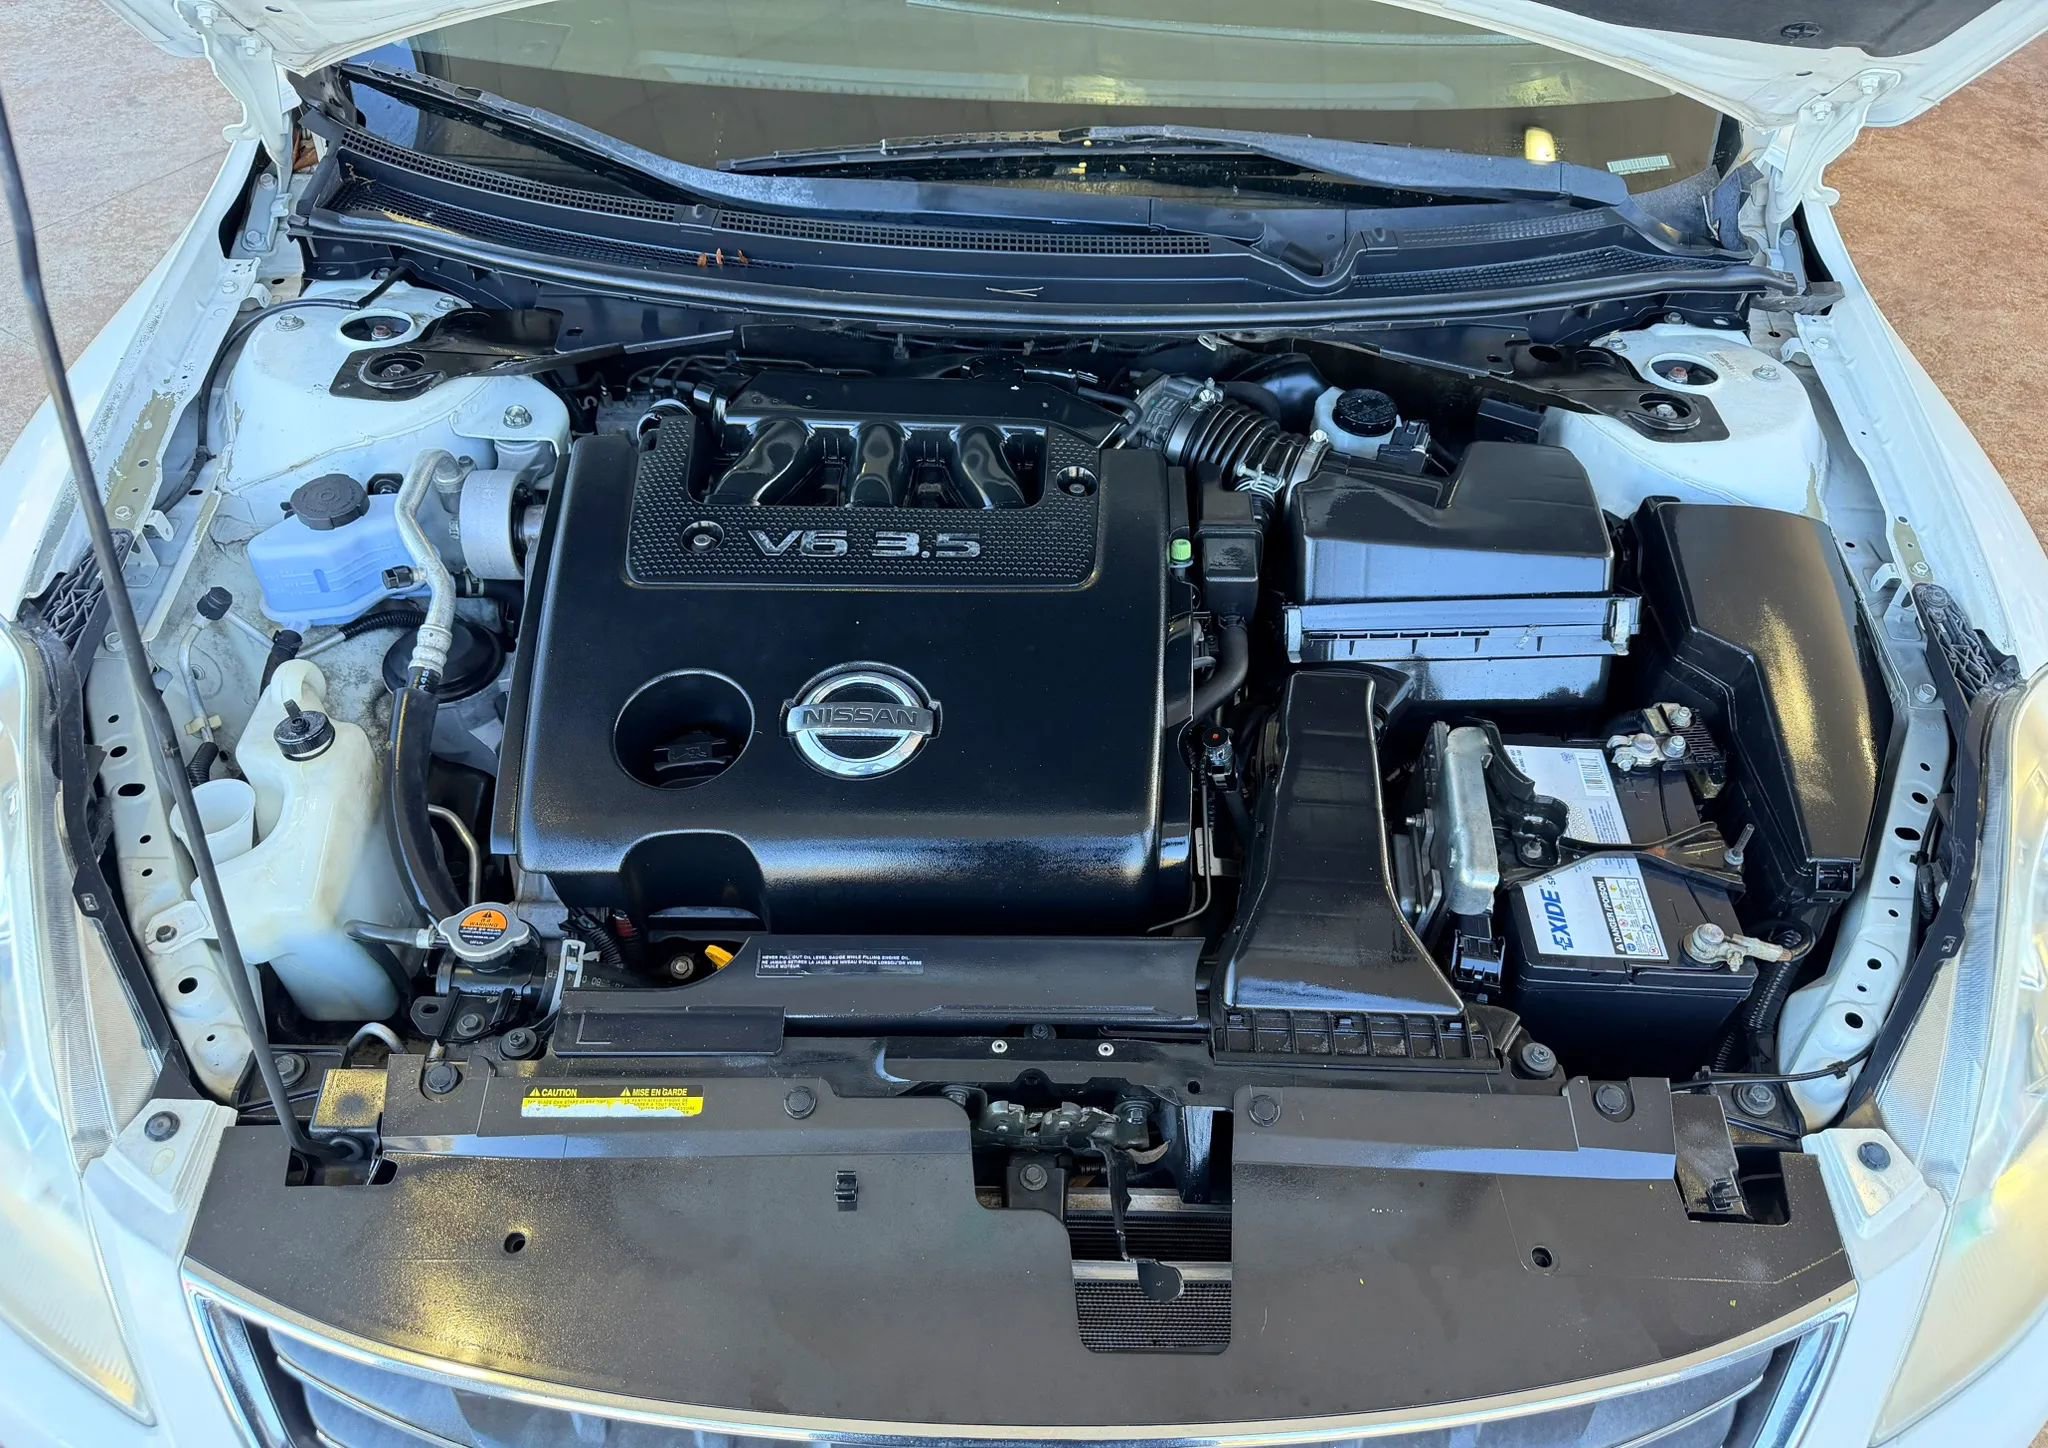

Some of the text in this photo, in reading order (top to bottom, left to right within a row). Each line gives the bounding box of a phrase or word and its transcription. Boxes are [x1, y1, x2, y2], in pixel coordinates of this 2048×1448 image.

[748, 530, 981, 558] V6 3.5
[802, 706, 918, 726] NISSAN
[1597, 880, 1612, 909] POISON
[1540, 887, 1574, 951] EXIDE
[1606, 912, 1622, 943] DANGER
[541, 1088, 578, 1097] CAUTION
[632, 1087, 688, 1096] MISE EN GARDE
